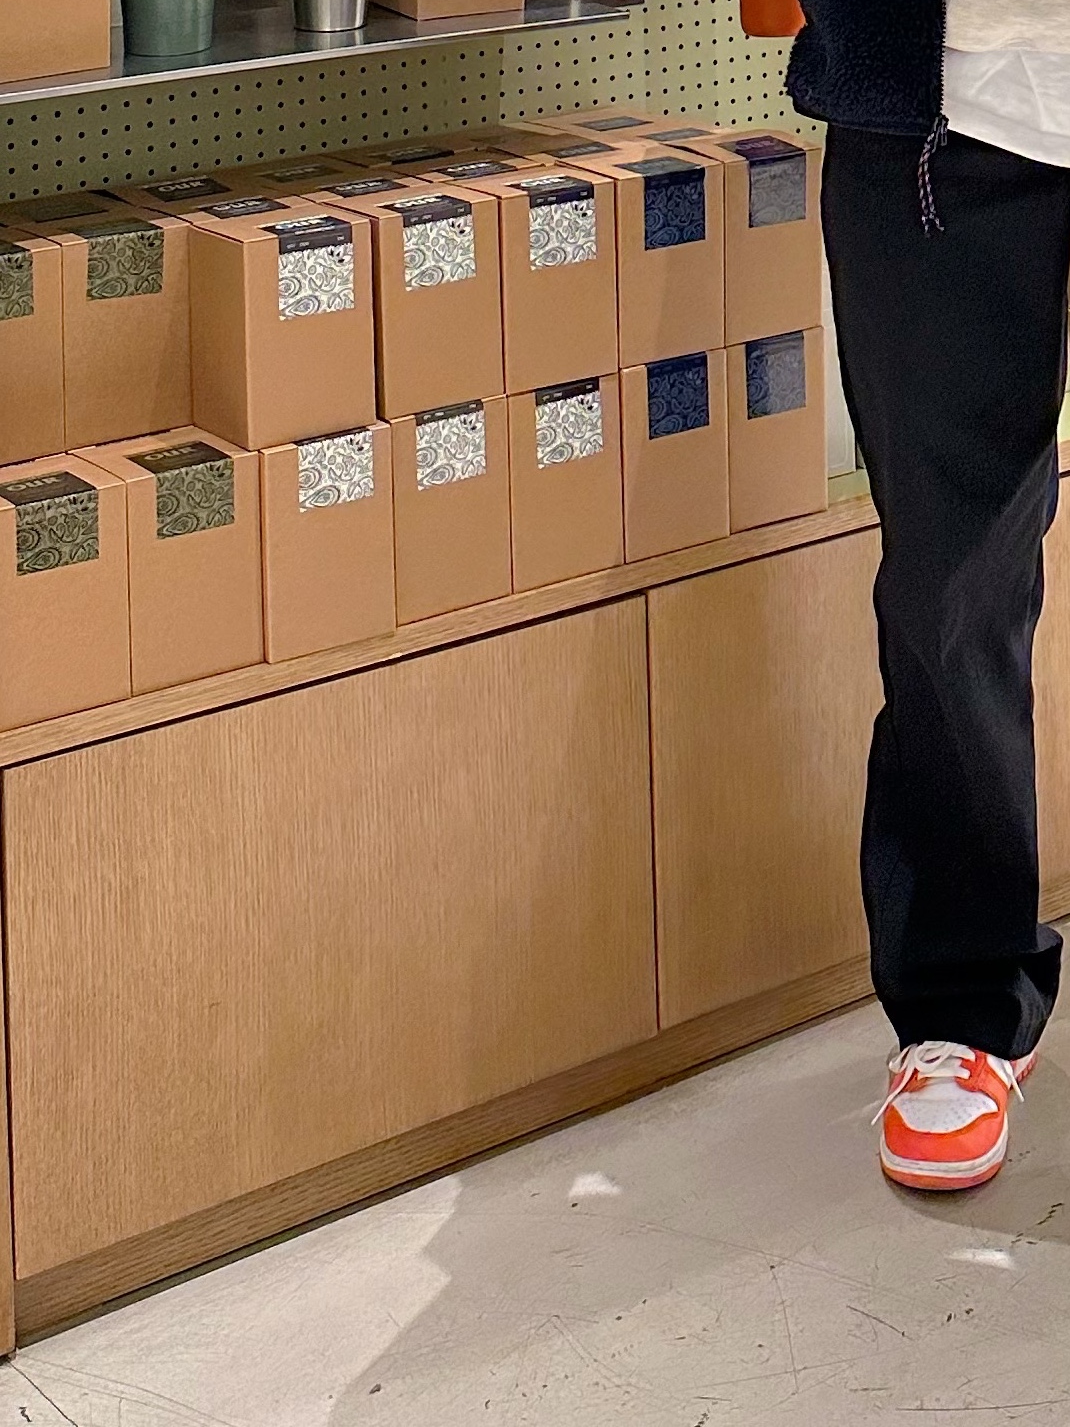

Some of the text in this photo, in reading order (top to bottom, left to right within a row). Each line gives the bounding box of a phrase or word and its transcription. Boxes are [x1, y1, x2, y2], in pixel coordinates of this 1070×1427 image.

[157, 179, 206, 193] OUR
[213, 197, 262, 212] OUR
[393, 195, 444, 209] OUR
[275, 216, 327, 231] OUR
[143, 445, 198, 461] OUR
[7, 476, 62, 492] OUR
